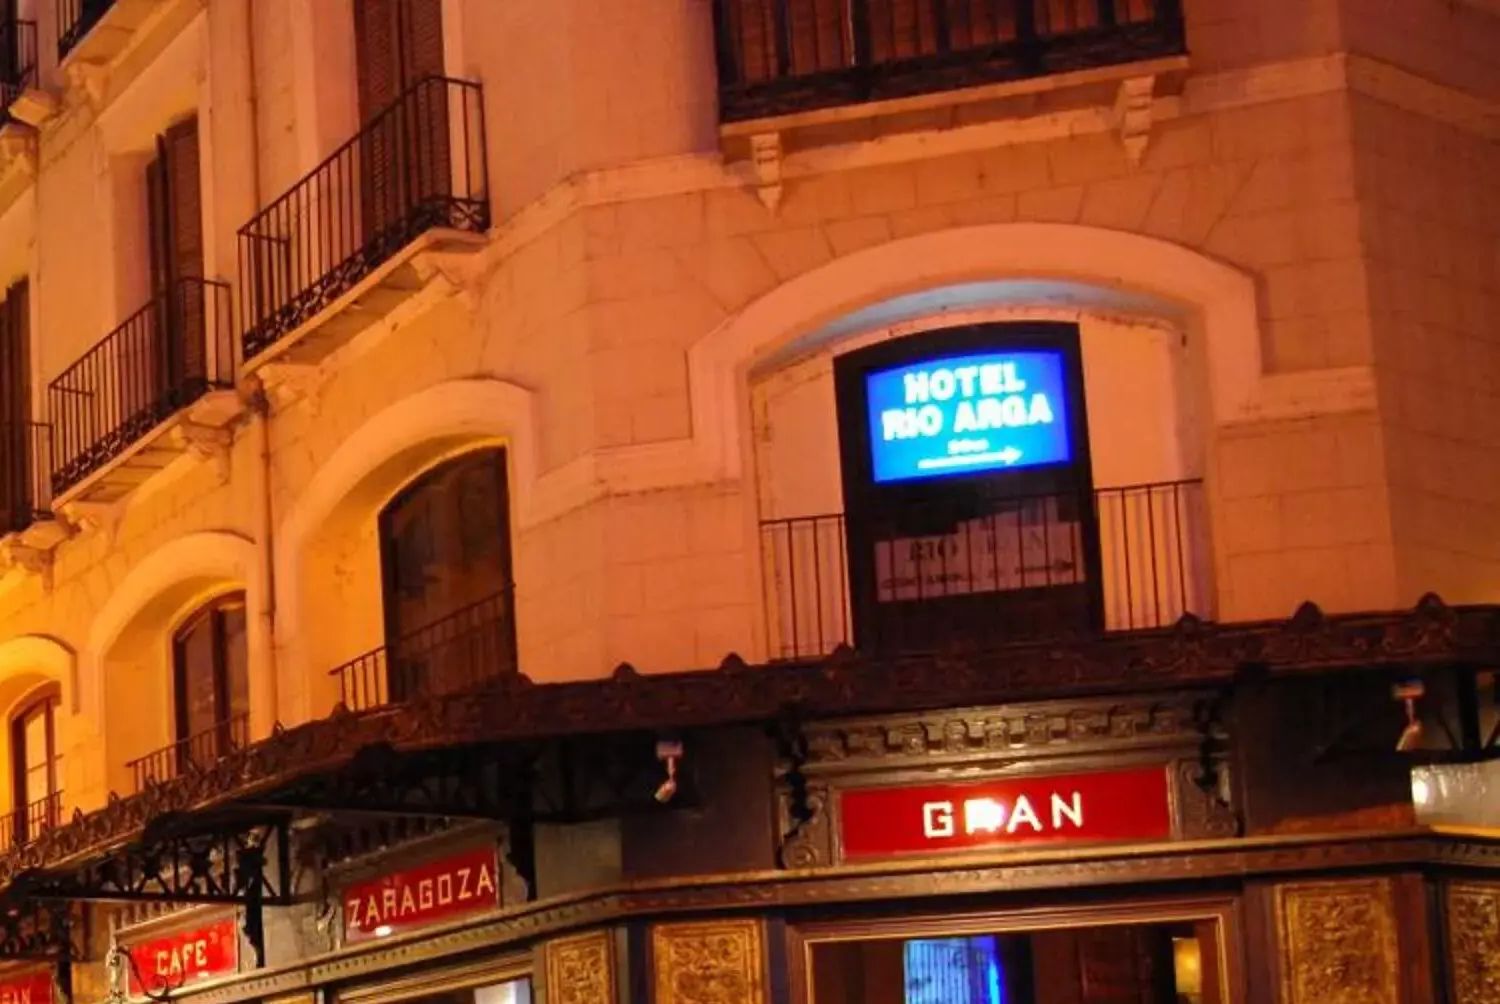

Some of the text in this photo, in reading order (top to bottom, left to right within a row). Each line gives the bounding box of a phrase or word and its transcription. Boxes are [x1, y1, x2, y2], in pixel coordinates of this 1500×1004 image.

[904, 361, 1026, 404] HOTEL
[882, 393, 1053, 440] RIO ARGA
[347, 863, 494, 928] ZARAGOZA
